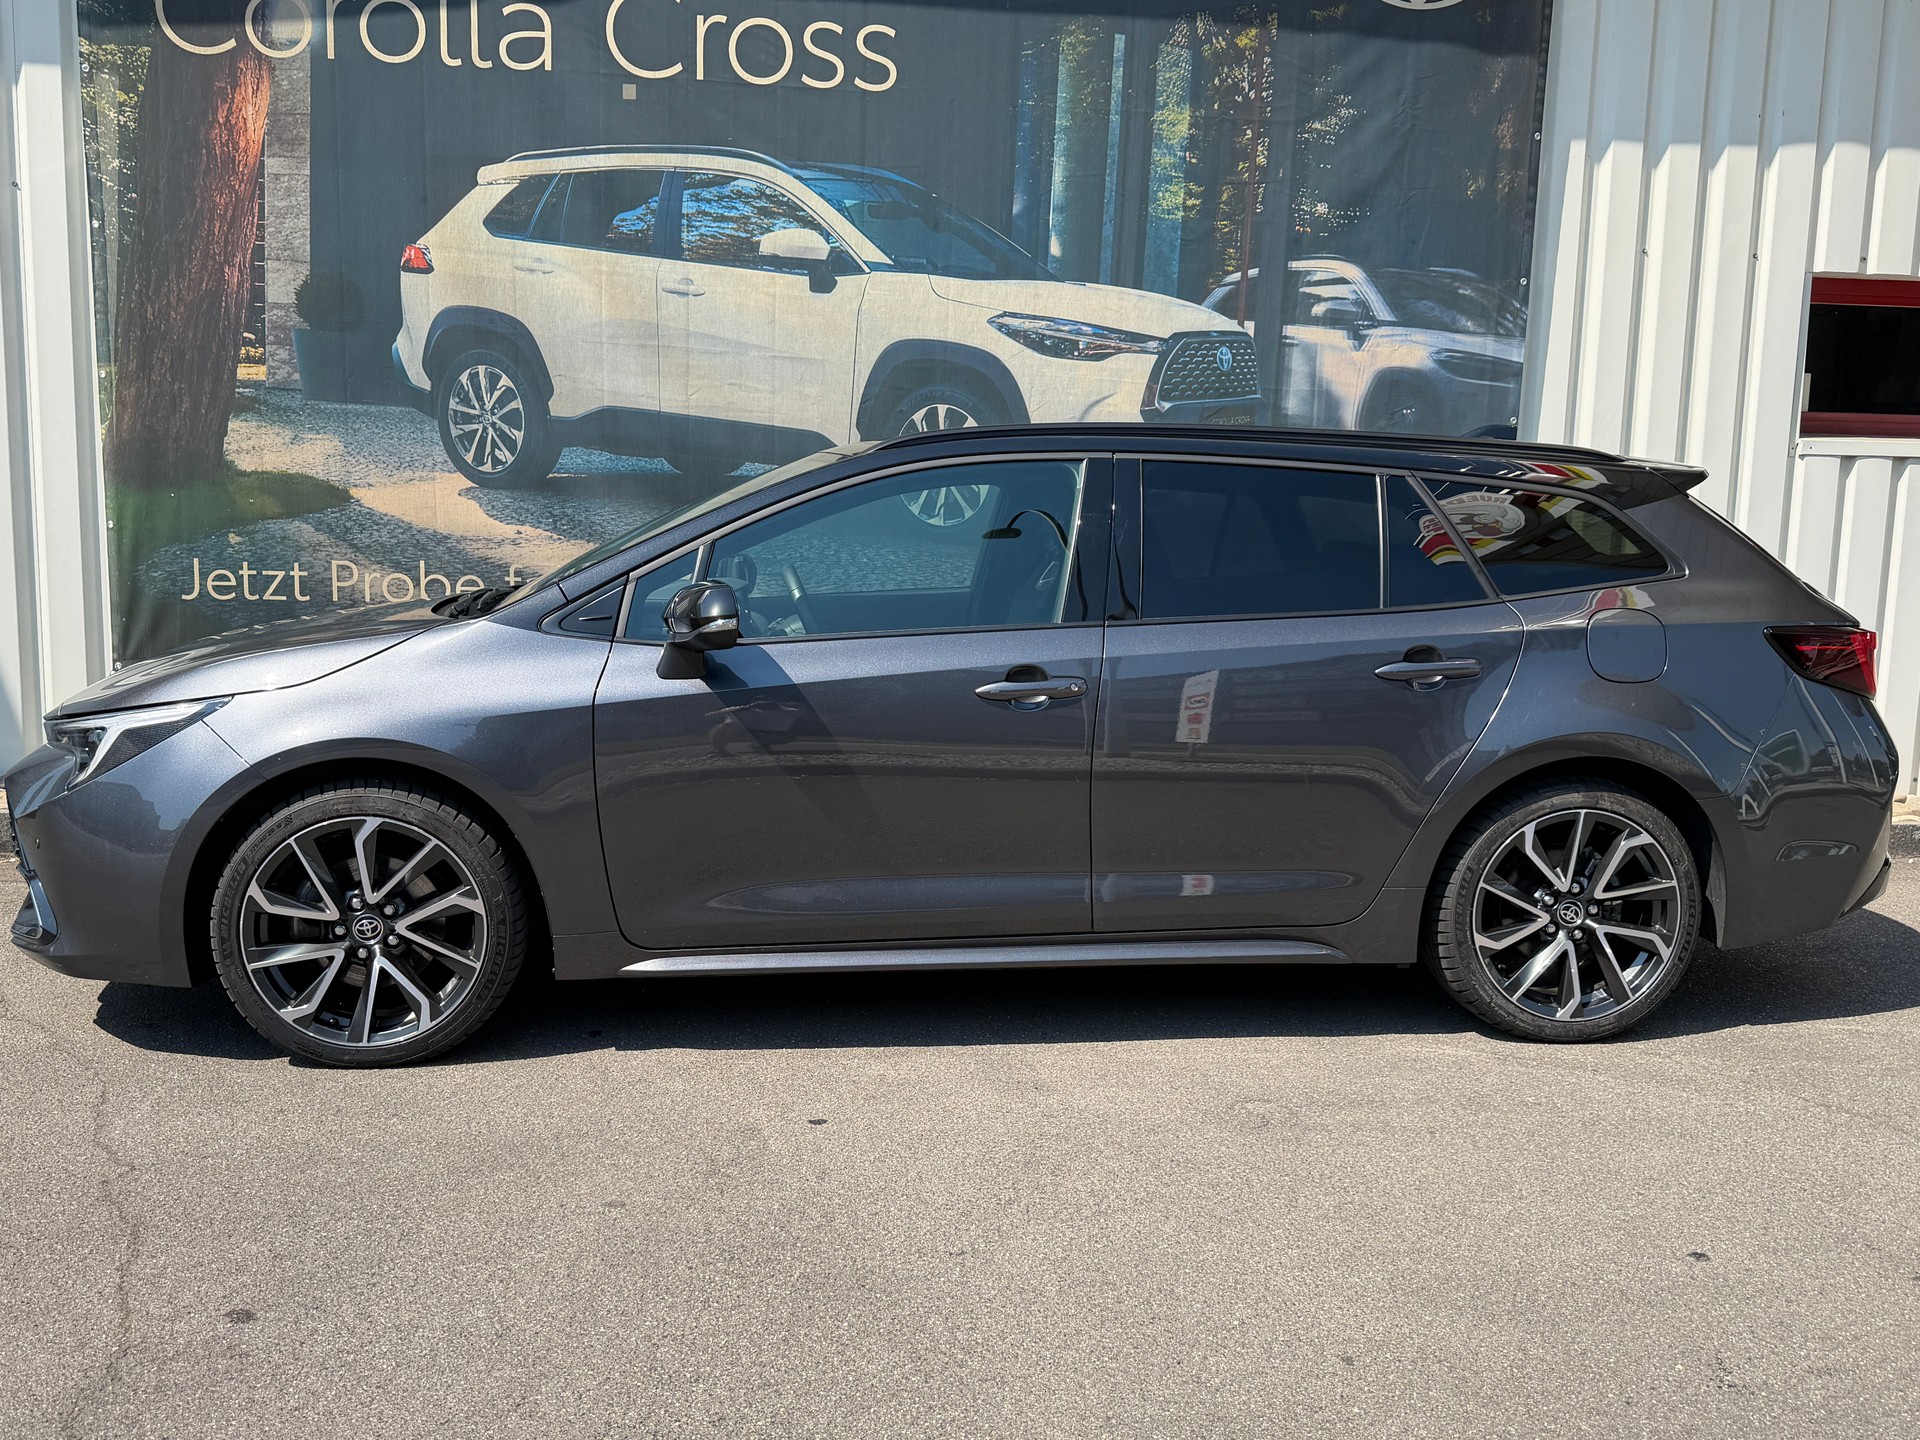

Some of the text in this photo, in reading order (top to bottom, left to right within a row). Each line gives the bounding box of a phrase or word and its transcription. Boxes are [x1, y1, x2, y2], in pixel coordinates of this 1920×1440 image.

[155, 0, 899, 92] Corolla Cross
[181, 558, 310, 600] Jetzt
[331, 560, 486, 603] Probe
